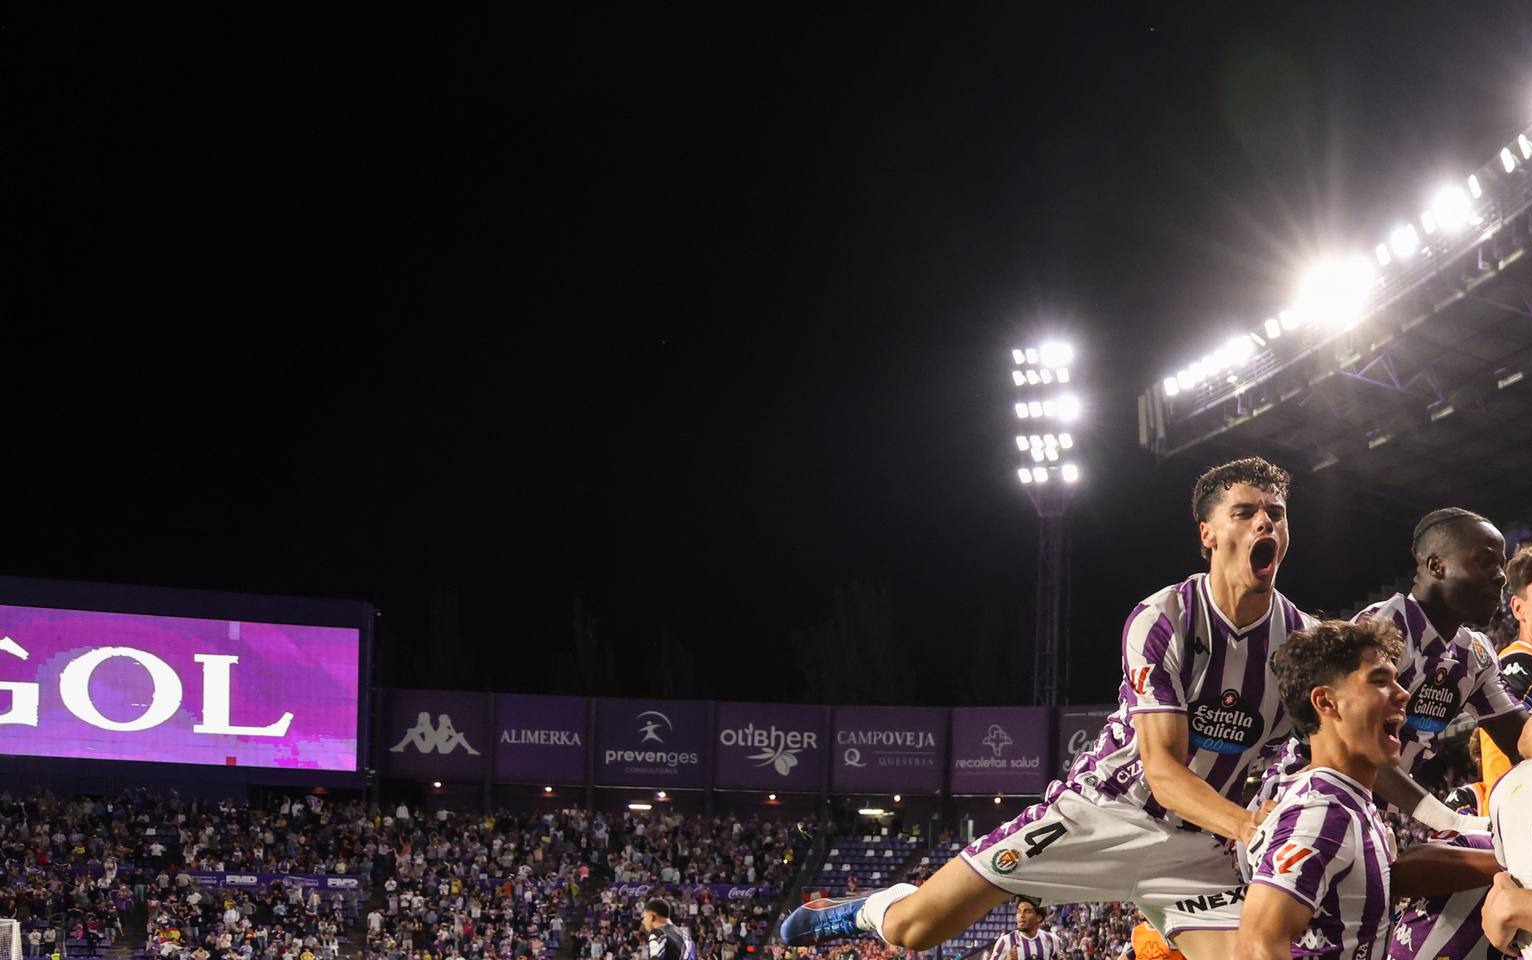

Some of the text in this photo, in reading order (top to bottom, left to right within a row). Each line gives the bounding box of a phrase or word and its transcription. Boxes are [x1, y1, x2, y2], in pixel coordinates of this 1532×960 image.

[1419, 684, 1453, 703] Estrella
[1194, 704, 1254, 728] Estrella
[1414, 699, 1447, 718] Galicia
[500, 729, 582, 746] ALIMERKA
[1192, 716, 1245, 742] Galicia
[837, 731, 936, 748] CAMPOVEJA
[605, 750, 698, 767] prevenges
[956, 755, 1040, 768] recoletas salud
[1024, 821, 1067, 858] 4
[1176, 886, 1245, 914] INEX
